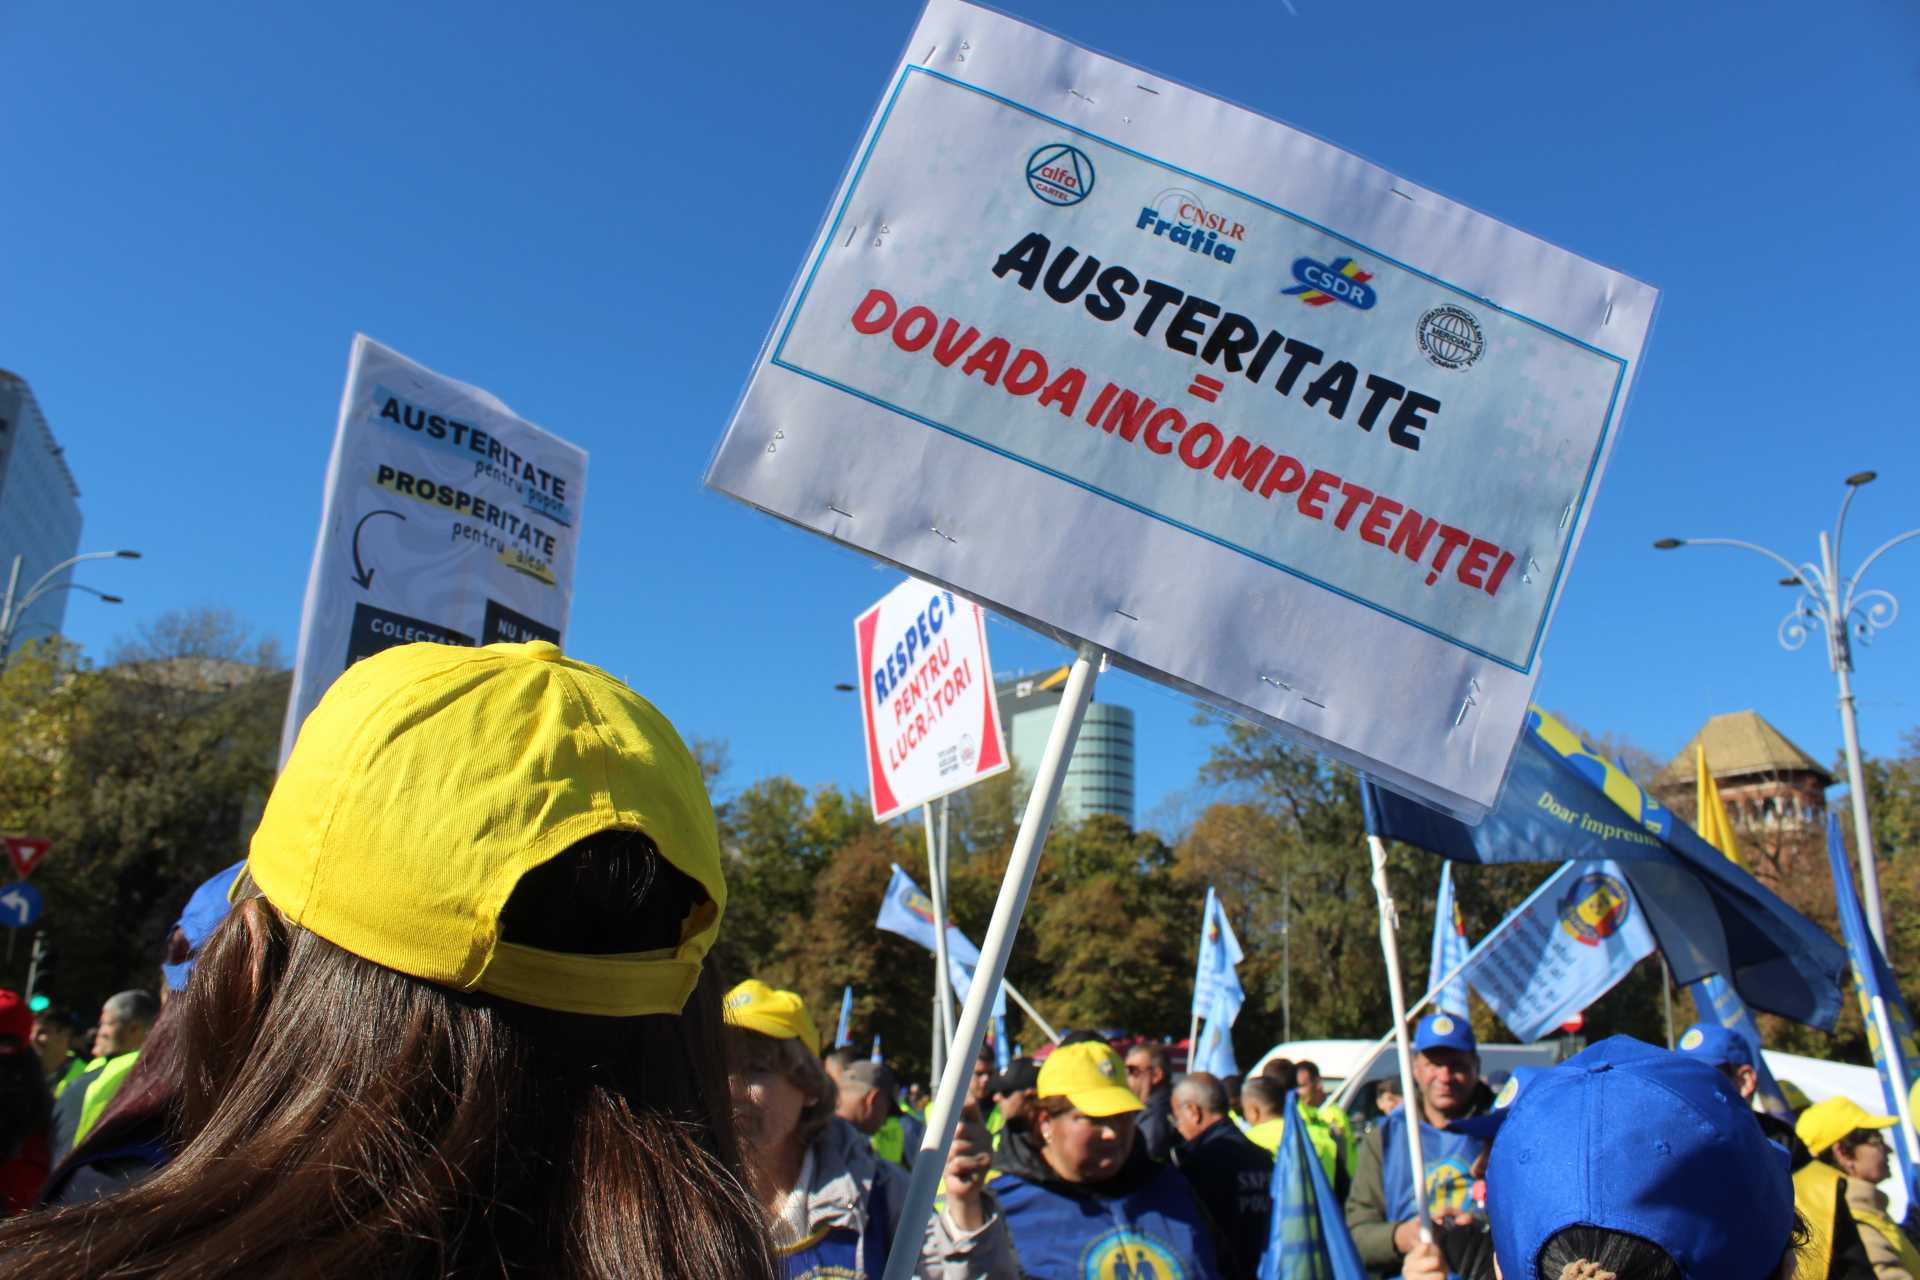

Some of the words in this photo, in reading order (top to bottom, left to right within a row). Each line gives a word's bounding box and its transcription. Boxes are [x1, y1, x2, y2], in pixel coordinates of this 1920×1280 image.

[1035, 182, 1069, 201] CARTEL
[1041, 164, 1077, 188] alfa
[1179, 203, 1245, 241] CNSLR
[1304, 266, 1365, 304] CSDR
[991, 232, 1441, 451] AUSTERITATE
[1432, 327, 1472, 349] MERIDIAN
[381, 397, 566, 501] AUSTERITATE
[851, 288, 1088, 418] DOVADA
[1086, 382, 1516, 596] INCOMPETENȚEI
[475, 461, 522, 494] pentru
[377, 465, 556, 556] PROSPERITATE
[452, 522, 504, 553] pentru
[498, 619, 517, 638] NU
[894, 638, 949, 725] PENTRU
[889, 658, 972, 771] LUCRĂTORI
[1538, 791, 1579, 824] Doar
